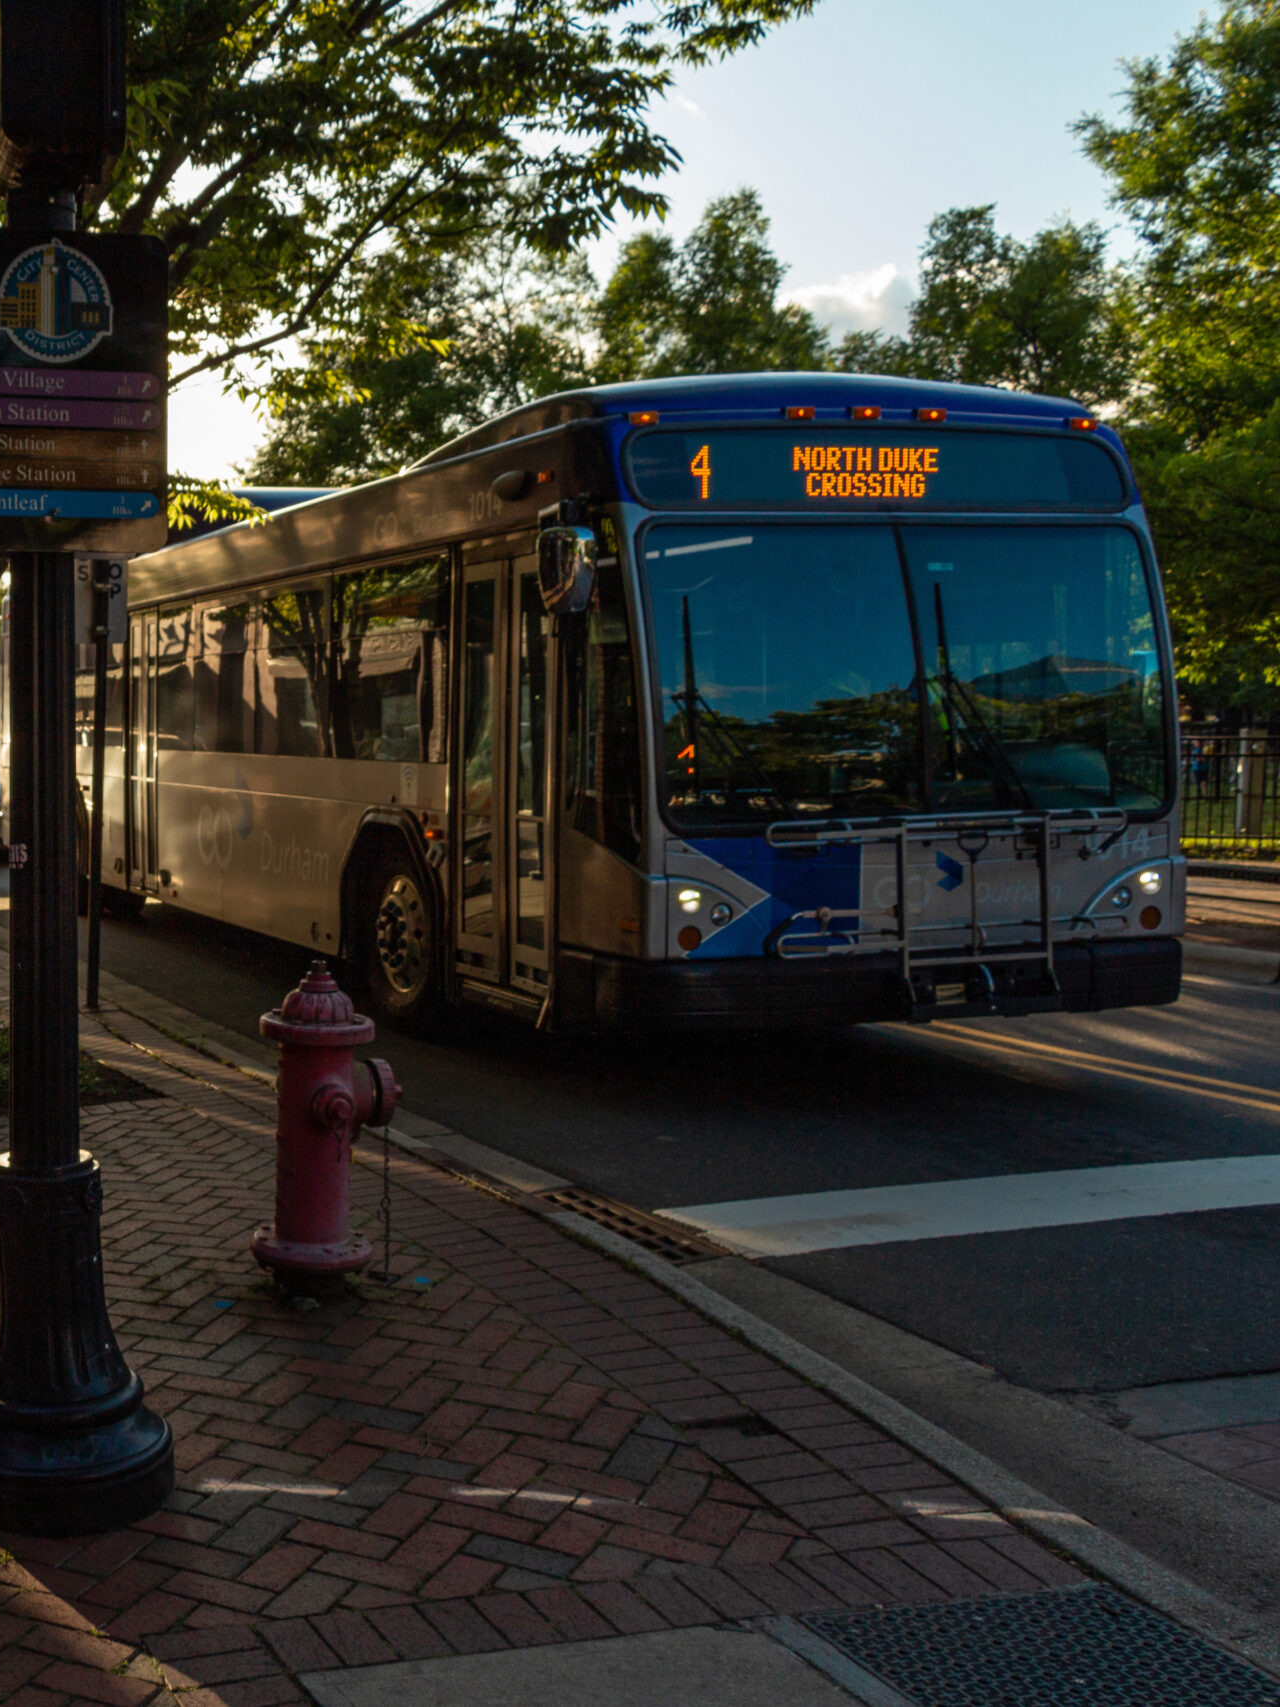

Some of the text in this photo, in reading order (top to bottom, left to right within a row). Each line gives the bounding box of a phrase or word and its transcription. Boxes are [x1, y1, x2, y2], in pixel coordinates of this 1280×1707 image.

[17, 256, 41, 281] CITY
[66, 258, 100, 304] CENTER
[25, 329, 87, 351] DISTRICT
[3, 370, 65, 393] Village
[8, 402, 70, 422] Station
[690, 445, 711, 499] 4
[792, 446, 939, 473] NORTH DUKE
[16, 464, 76, 483] Station
[805, 472, 926, 498] CROSSING
[259, 830, 330, 885] Durham
